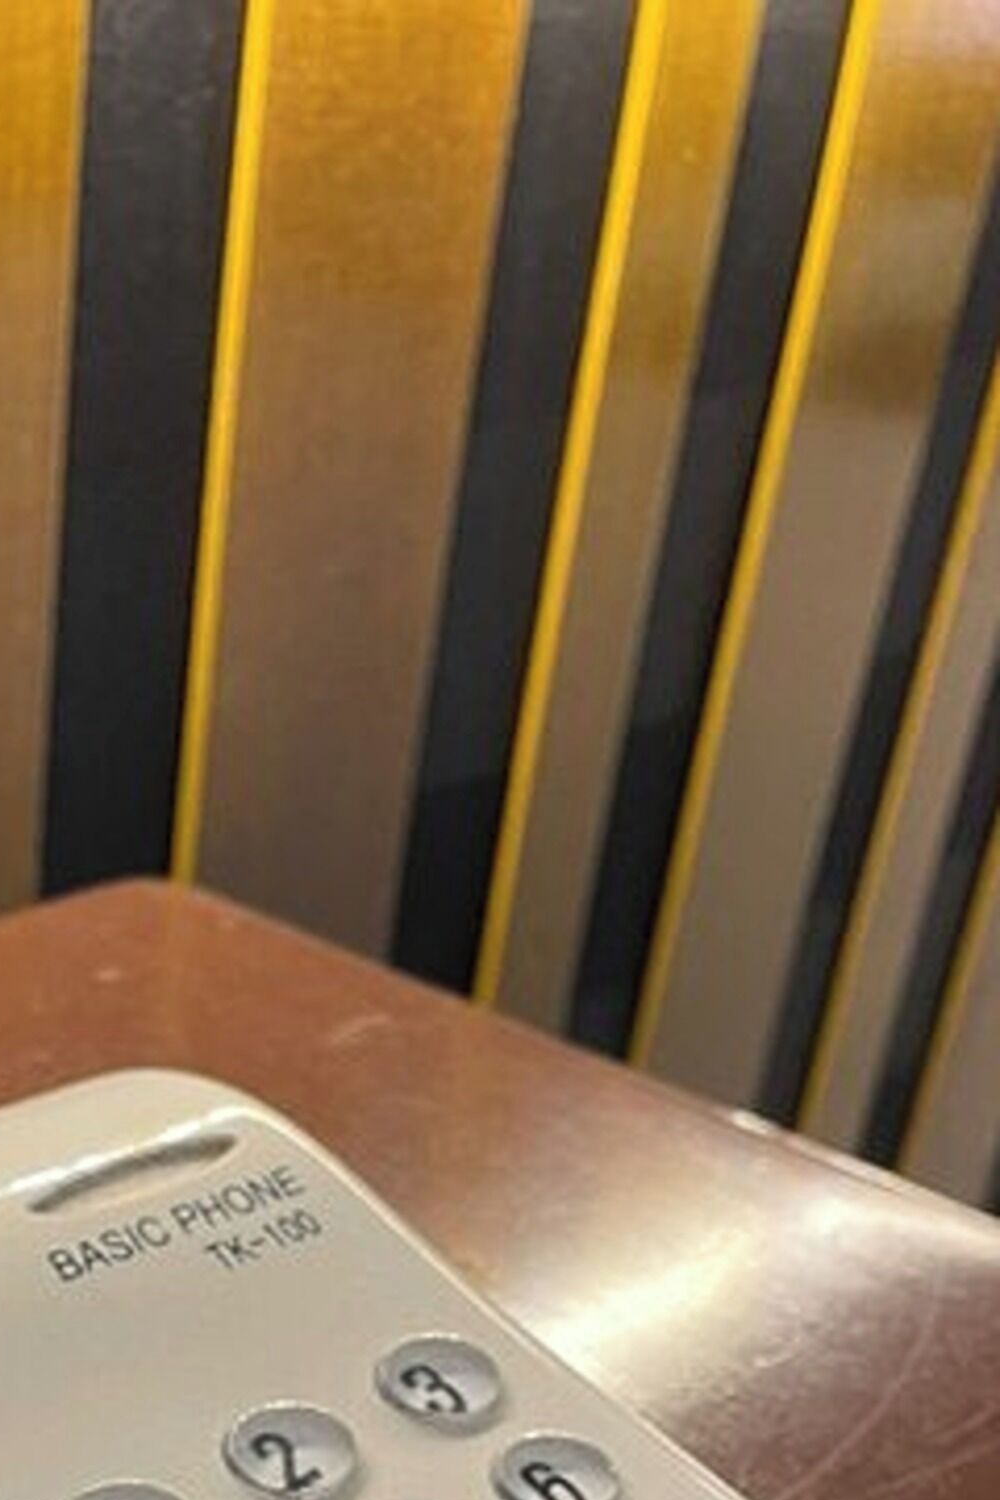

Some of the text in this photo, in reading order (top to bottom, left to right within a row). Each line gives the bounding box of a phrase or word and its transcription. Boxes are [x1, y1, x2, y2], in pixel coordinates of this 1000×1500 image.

[47, 1165, 305, 1282] BASIC PHONE
[204, 1208, 322, 1270] TK-100
[400, 1363, 468, 1415] 3
[252, 1431, 323, 1493] 2
